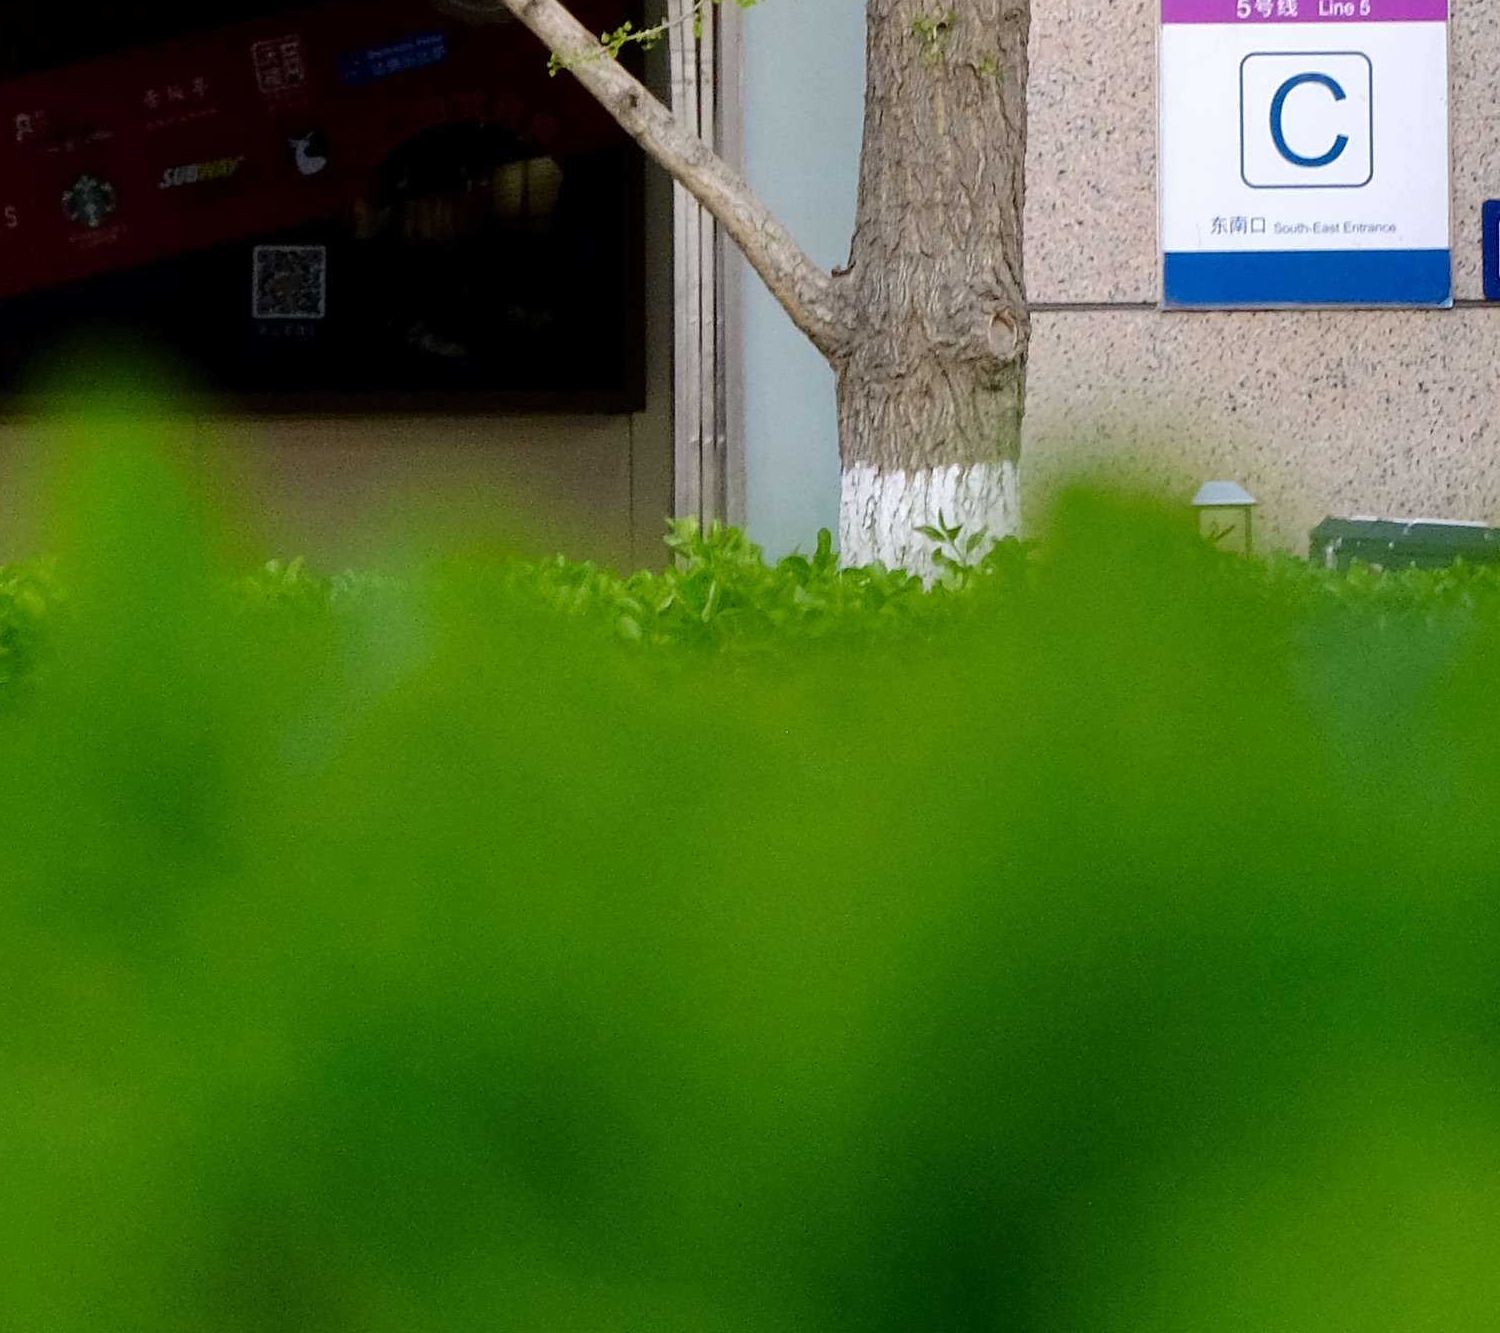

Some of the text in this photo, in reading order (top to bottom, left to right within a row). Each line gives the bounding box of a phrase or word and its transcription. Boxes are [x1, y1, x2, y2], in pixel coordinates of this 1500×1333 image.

[1269, 71, 1349, 168] C
[158, 155, 246, 190] SUBWAY
[1211, 215, 1266, 235] 东南口
[1343, 220, 1398, 235] Entrance
